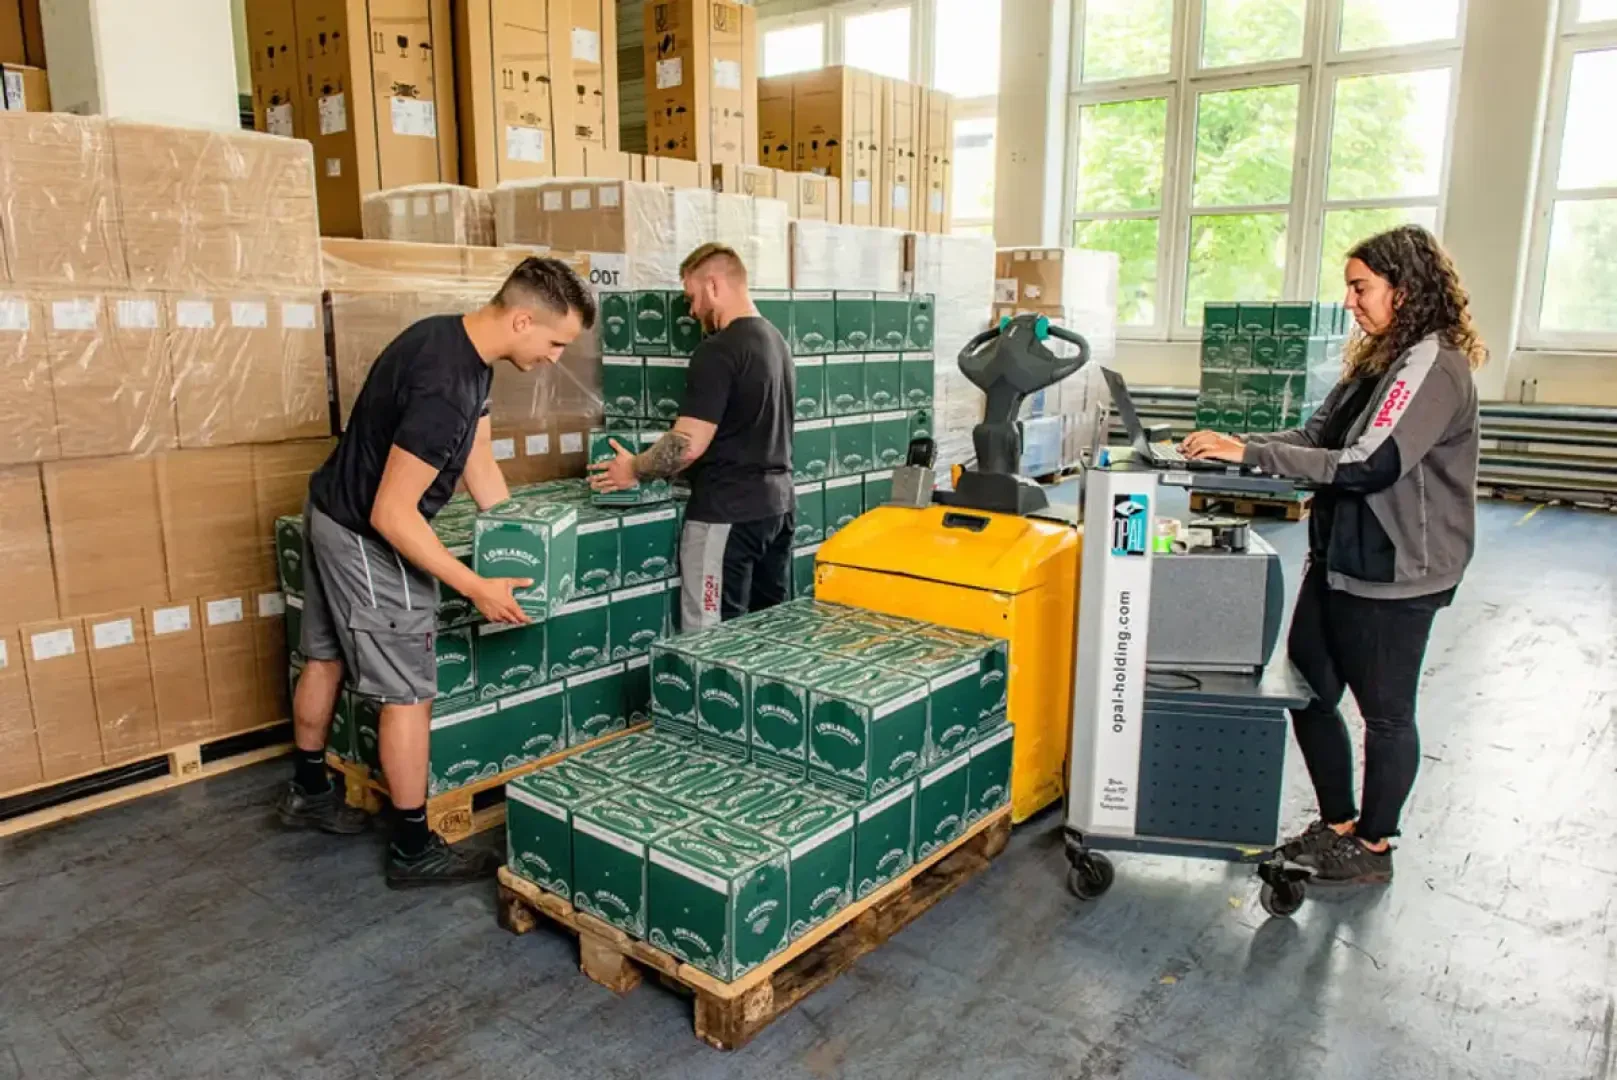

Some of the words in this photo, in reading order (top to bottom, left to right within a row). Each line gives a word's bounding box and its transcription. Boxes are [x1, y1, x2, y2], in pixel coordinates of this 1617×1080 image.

[1112, 518, 1145, 551] OPAL
[482, 548, 541, 567] LOWLANDER
[1111, 590, 1131, 733] opal-holding.com
[756, 703, 799, 725] LOWLANDER
[815, 722, 861, 746] LOWLANDER
